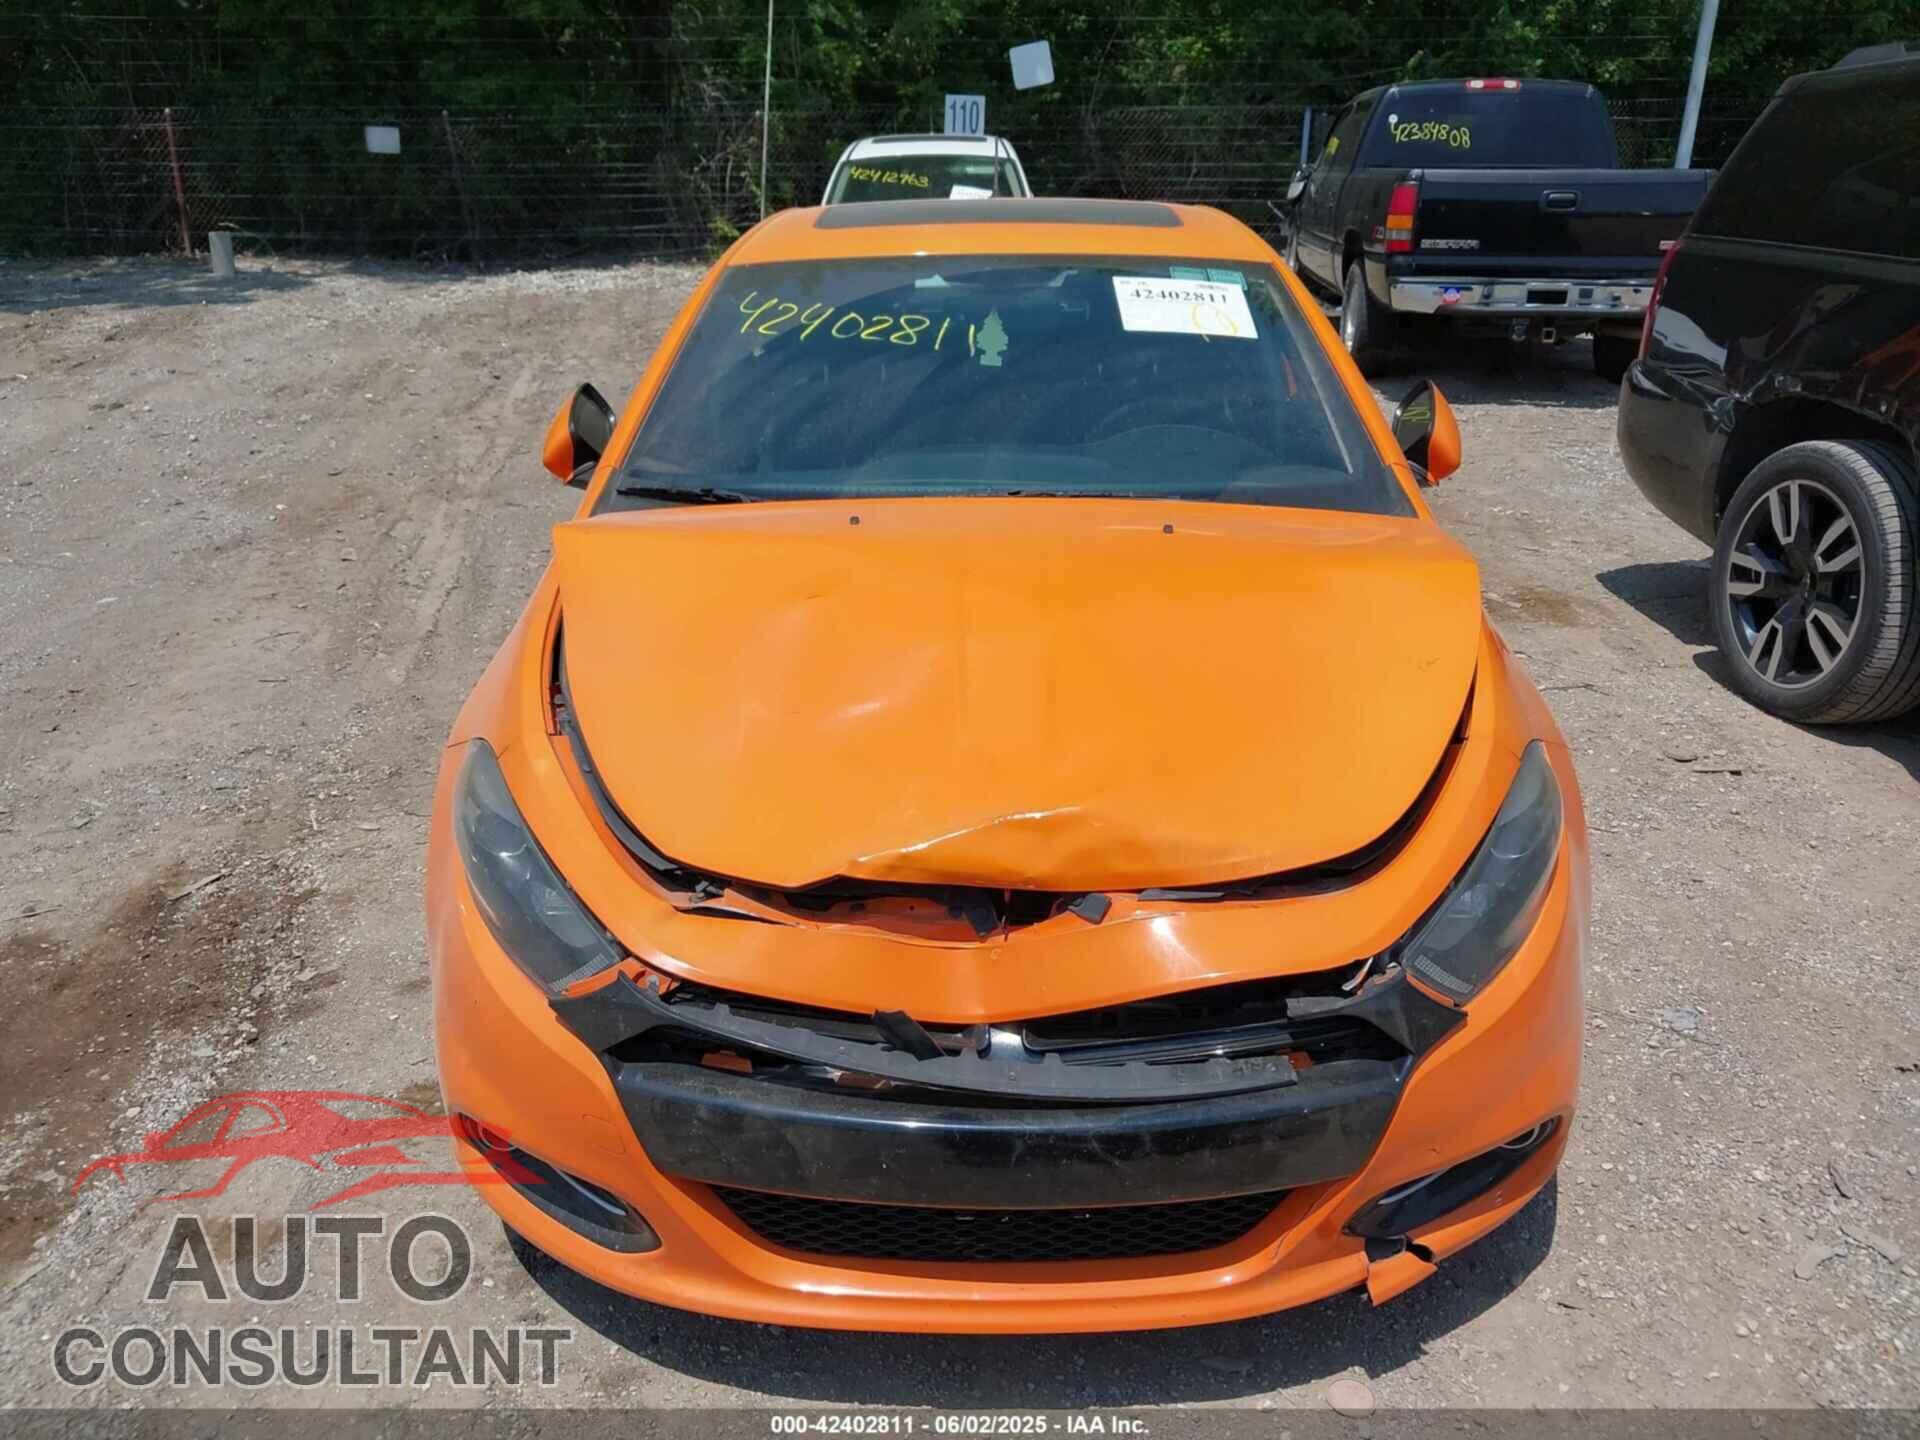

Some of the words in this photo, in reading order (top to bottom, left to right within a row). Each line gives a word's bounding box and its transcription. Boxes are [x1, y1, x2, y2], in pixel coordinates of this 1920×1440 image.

[950, 100, 980, 133] 110
[1390, 121, 1471, 148] 42384808
[1130, 288, 1228, 303] 42402811
[739, 291, 976, 357] 42402811
